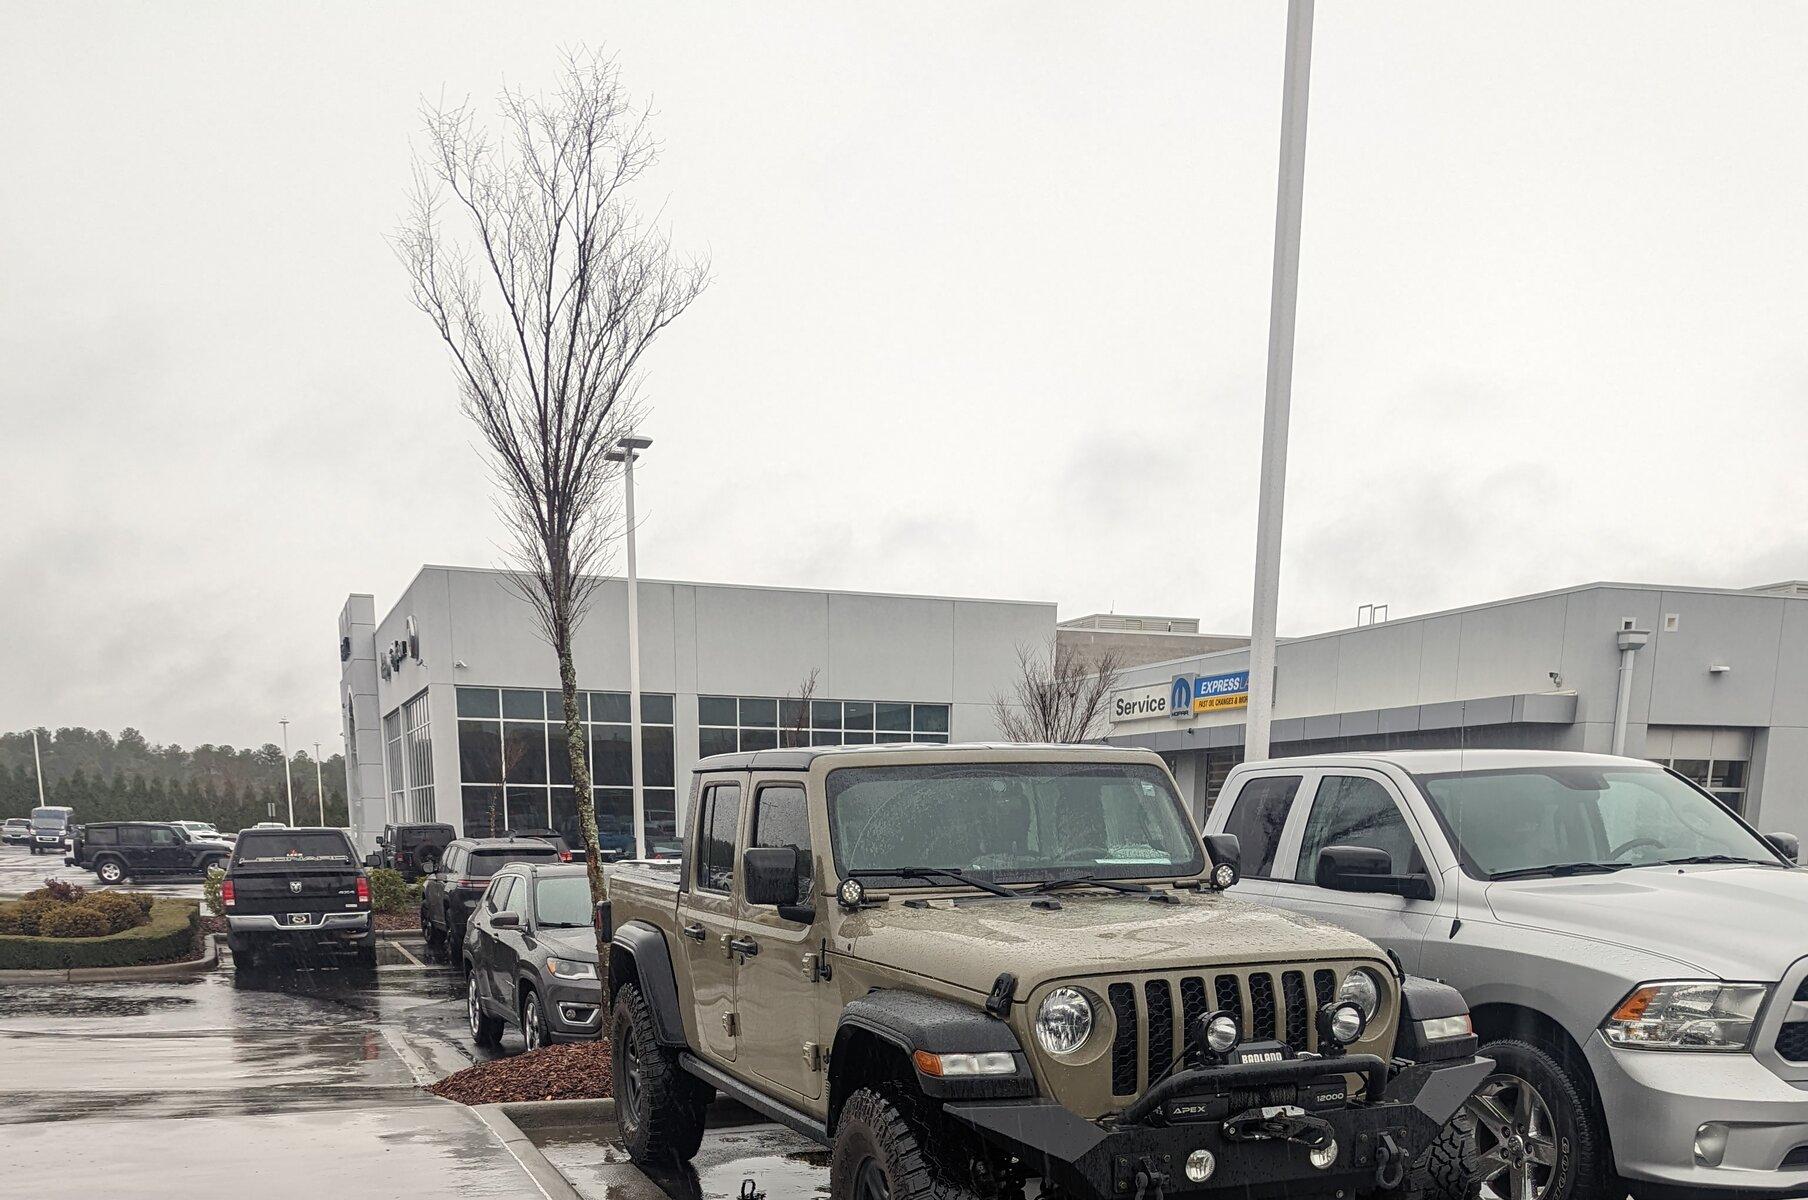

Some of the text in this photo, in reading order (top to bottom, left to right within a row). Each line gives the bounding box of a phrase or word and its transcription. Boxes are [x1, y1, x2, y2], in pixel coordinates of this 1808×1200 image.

[1200, 677, 1240, 695] EXPRESS
[1116, 695, 1166, 716] Service
[1215, 697, 1234, 706] CHANGES
[1241, 1052, 1283, 1064] BADLAND
[1316, 1092, 1344, 1102] 12000
[1173, 1105, 1207, 1114] APEX
